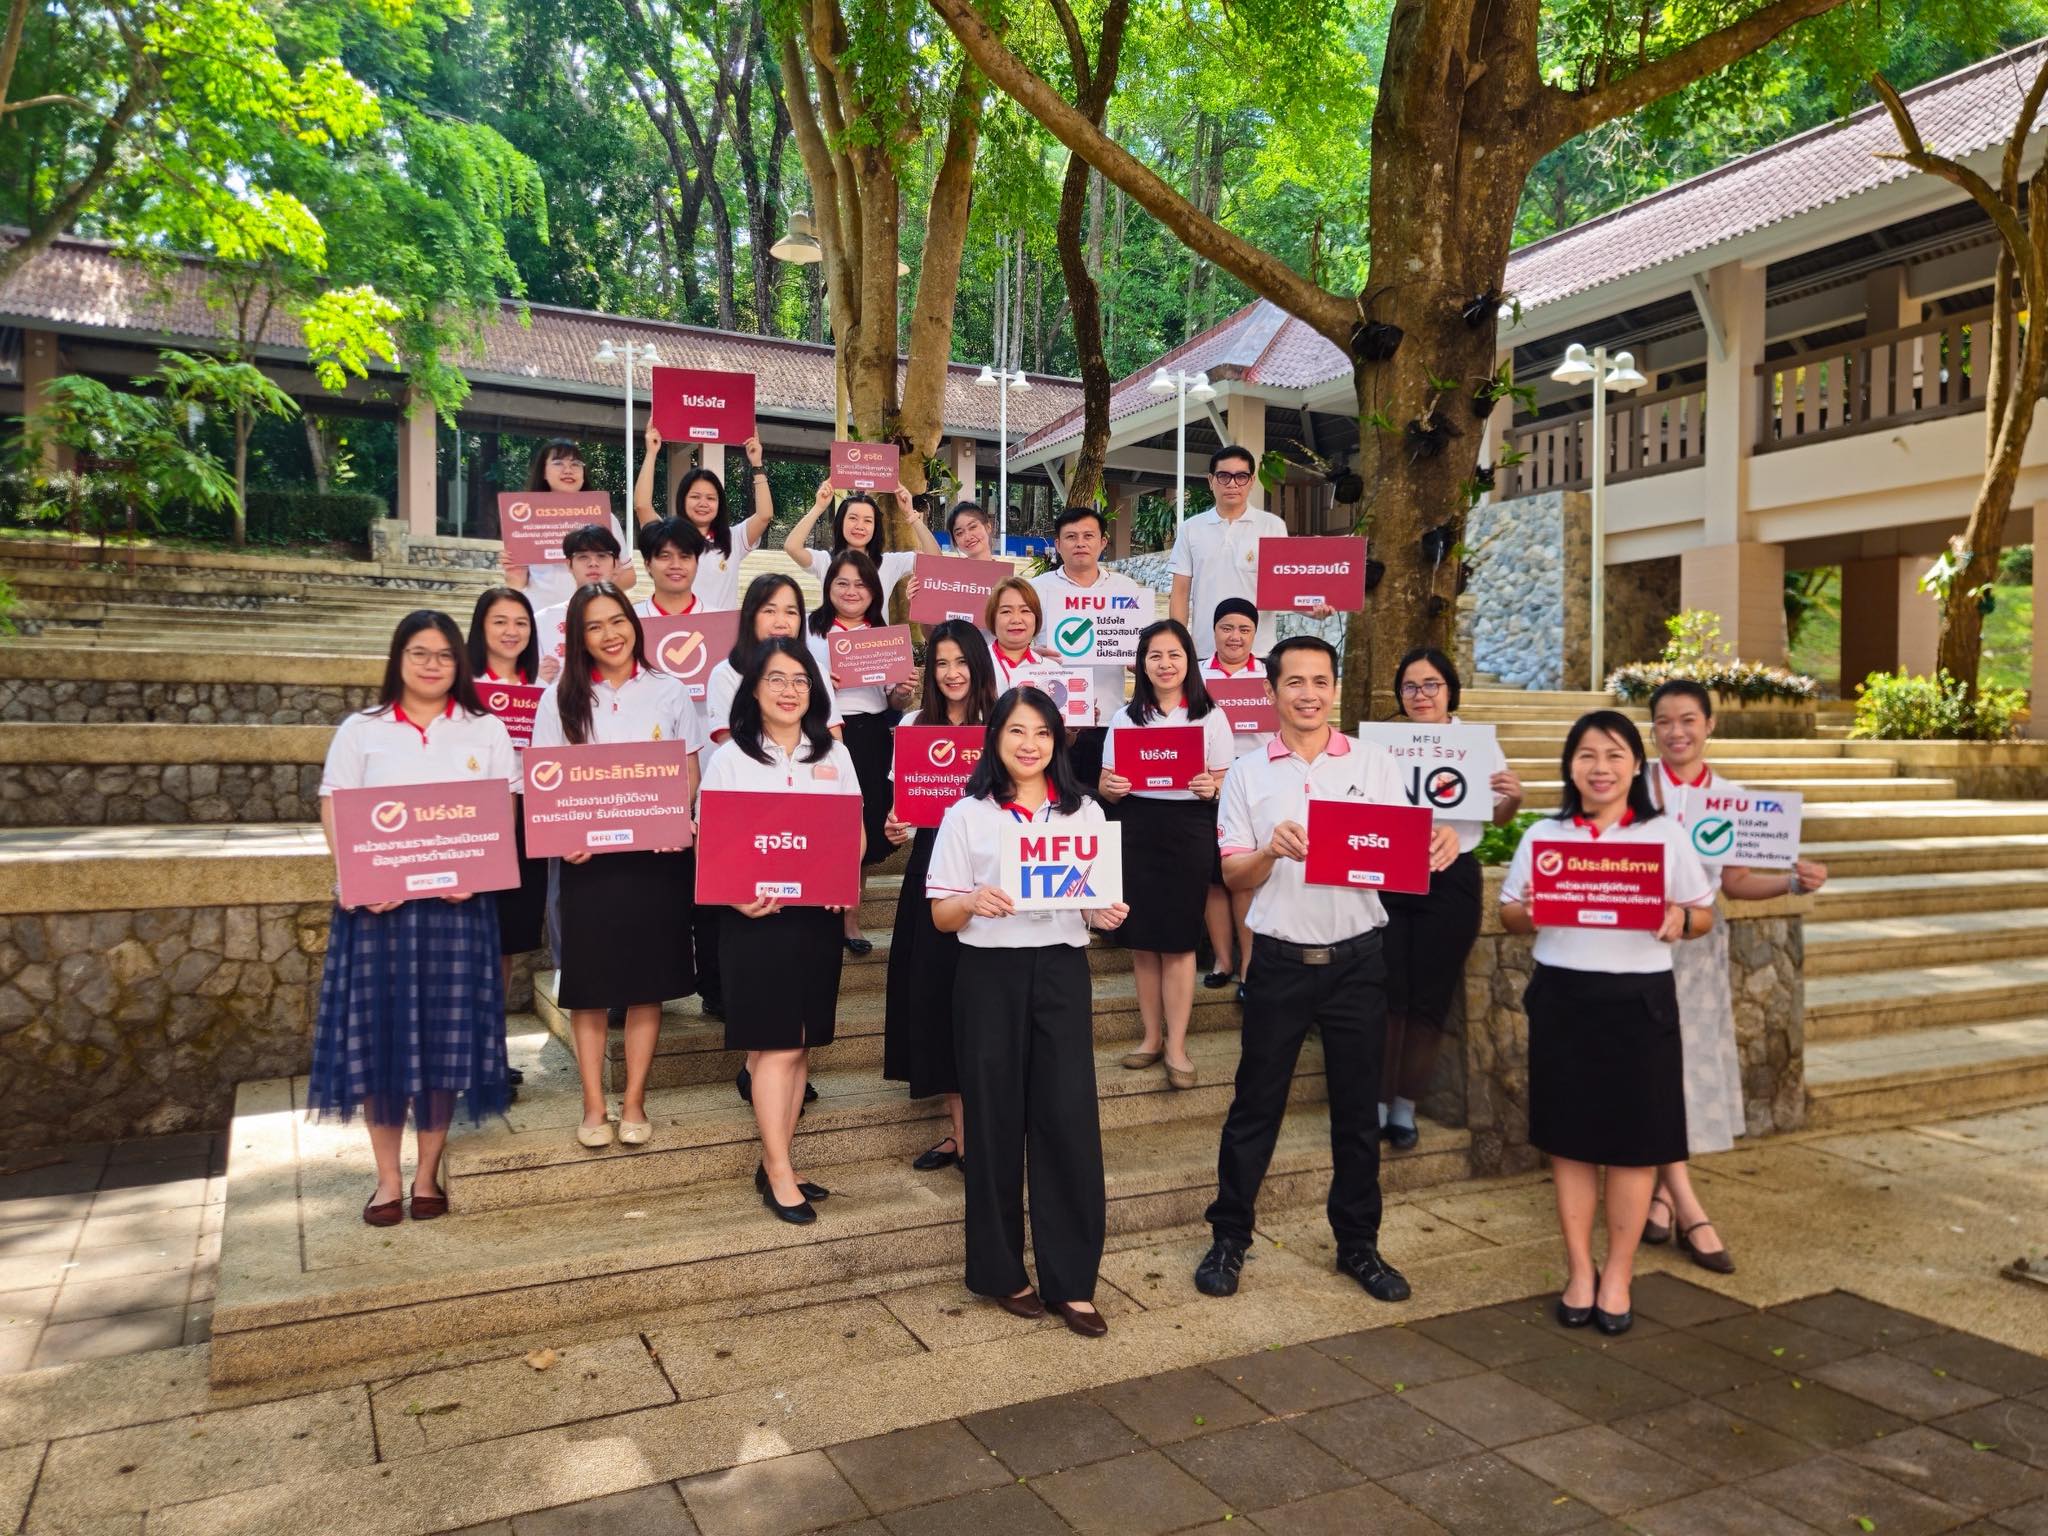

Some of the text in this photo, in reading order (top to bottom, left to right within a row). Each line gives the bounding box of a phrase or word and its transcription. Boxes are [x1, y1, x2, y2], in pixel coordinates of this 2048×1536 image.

[682, 394, 726, 409] โปร่งใส
[535, 503, 602, 517] ตรวจสอบได้
[1273, 562, 1350, 575] ตรวจสอบได้
[923, 578, 992, 595] มีประสิทธิภา
[1065, 596, 1140, 610] MFU ITA
[1096, 616, 1125, 625] โปร่งใส
[855, 637, 904, 650] ตรวจสอบได้
[1096, 639, 1119, 649] สุจริต
[512, 697, 537, 709] โปร่ง
[1412, 735, 1441, 744] MFU
[961, 747, 983, 764] สุจ
[1140, 749, 1178, 761] โปร่งใส
[1432, 746, 1467, 761] Say
[569, 763, 680, 783] มีประสิทธิภาพ
[908, 786, 956, 798] อย่างสุจริต
[557, 792, 658, 808] หน่วยงานปฏิบัติงาน
[1705, 797, 1784, 814] MFU ITA
[413, 804, 477, 822] โปร่งใส
[532, 805, 684, 824] ตามระเบียบ รับผิดชอบต่องาน
[591, 834, 611, 842] MFU
[754, 831, 808, 855] สุจริต
[1347, 833, 1390, 851] สุจริต
[1020, 835, 1098, 862] MFU
[1567, 857, 1659, 873] มีประสิทธิภาพ
[1020, 864, 1097, 898] ITA
[782, 886, 799, 894] ITA
